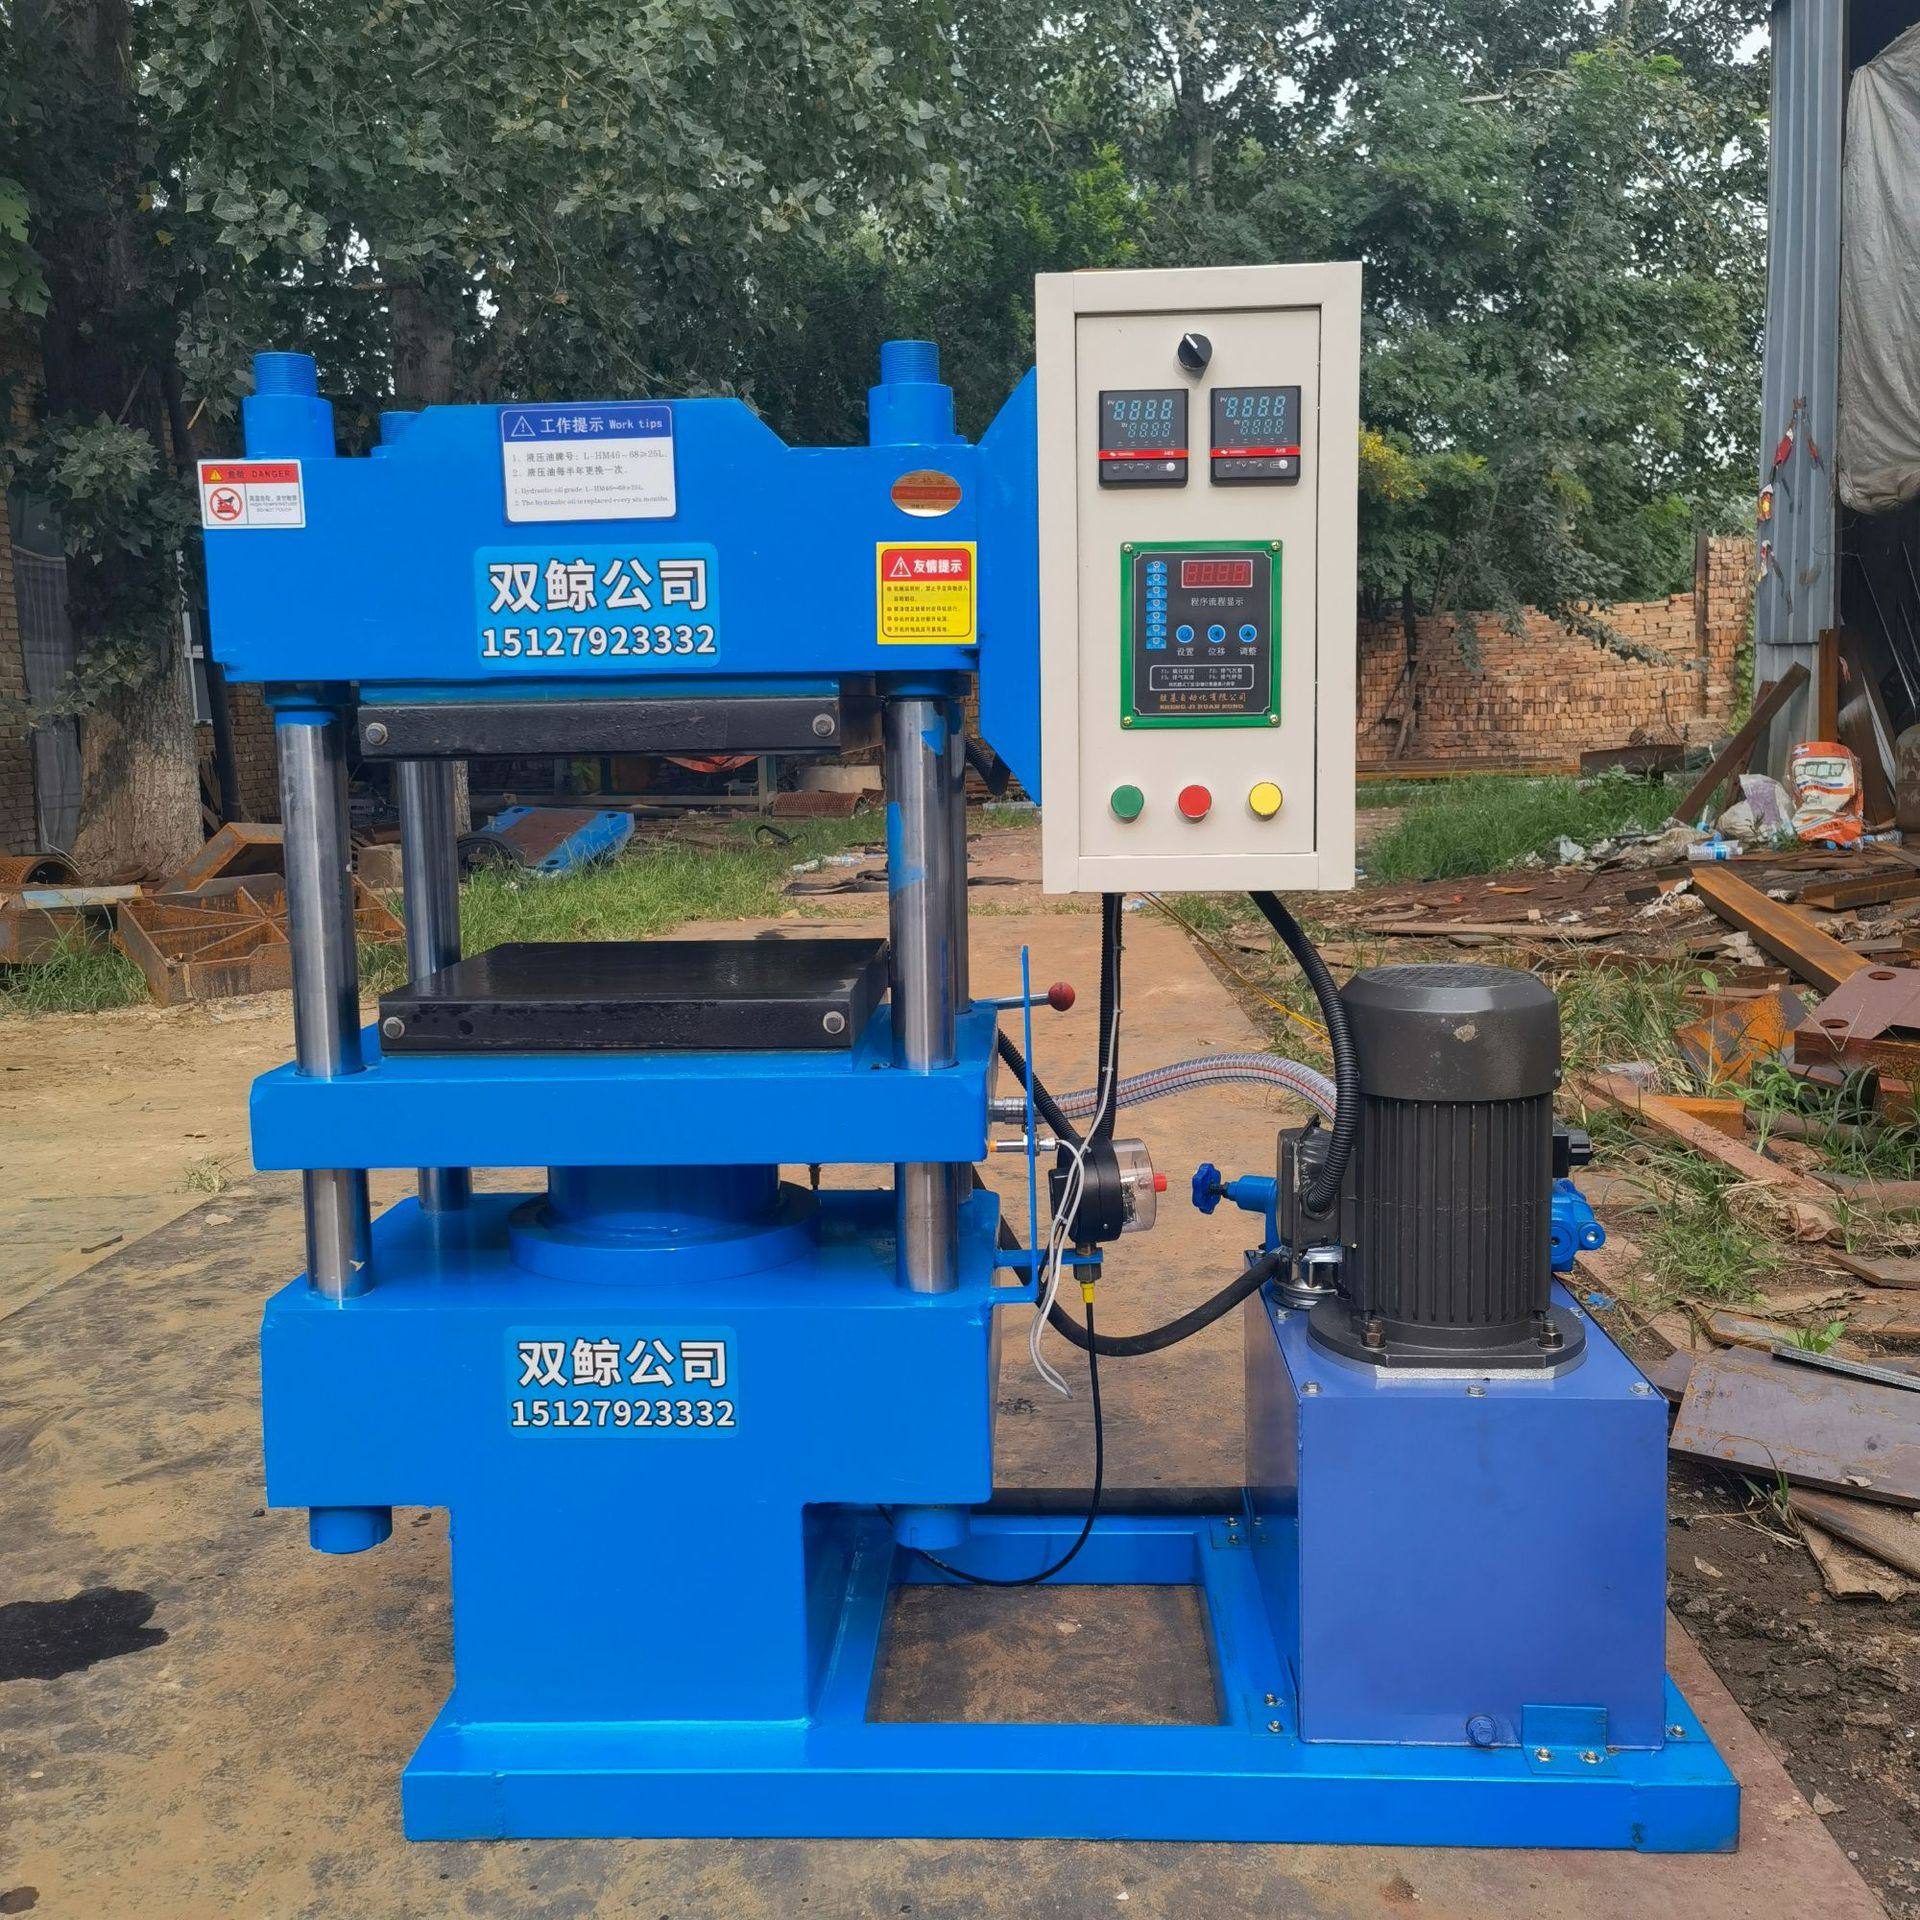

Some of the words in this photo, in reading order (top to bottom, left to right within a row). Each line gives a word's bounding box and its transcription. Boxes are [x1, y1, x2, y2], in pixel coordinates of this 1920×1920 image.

[540, 416, 604, 434] 工作提示
[608, 419, 634, 431] Work
[639, 418, 663, 430] tips
[251, 470, 291, 478] DANGER
[913, 559, 962, 574] 友情提示
[488, 557, 708, 615] 双鲸公司
[1191, 597, 1244, 607] 程序流程显示
[482, 623, 717, 658] 15127923332
[1177, 647, 1194, 656] 设置
[1239, 647, 1257, 656] 调整
[517, 1336, 727, 1388] 双鲸公司
[511, 1399, 737, 1427] 15127923332
